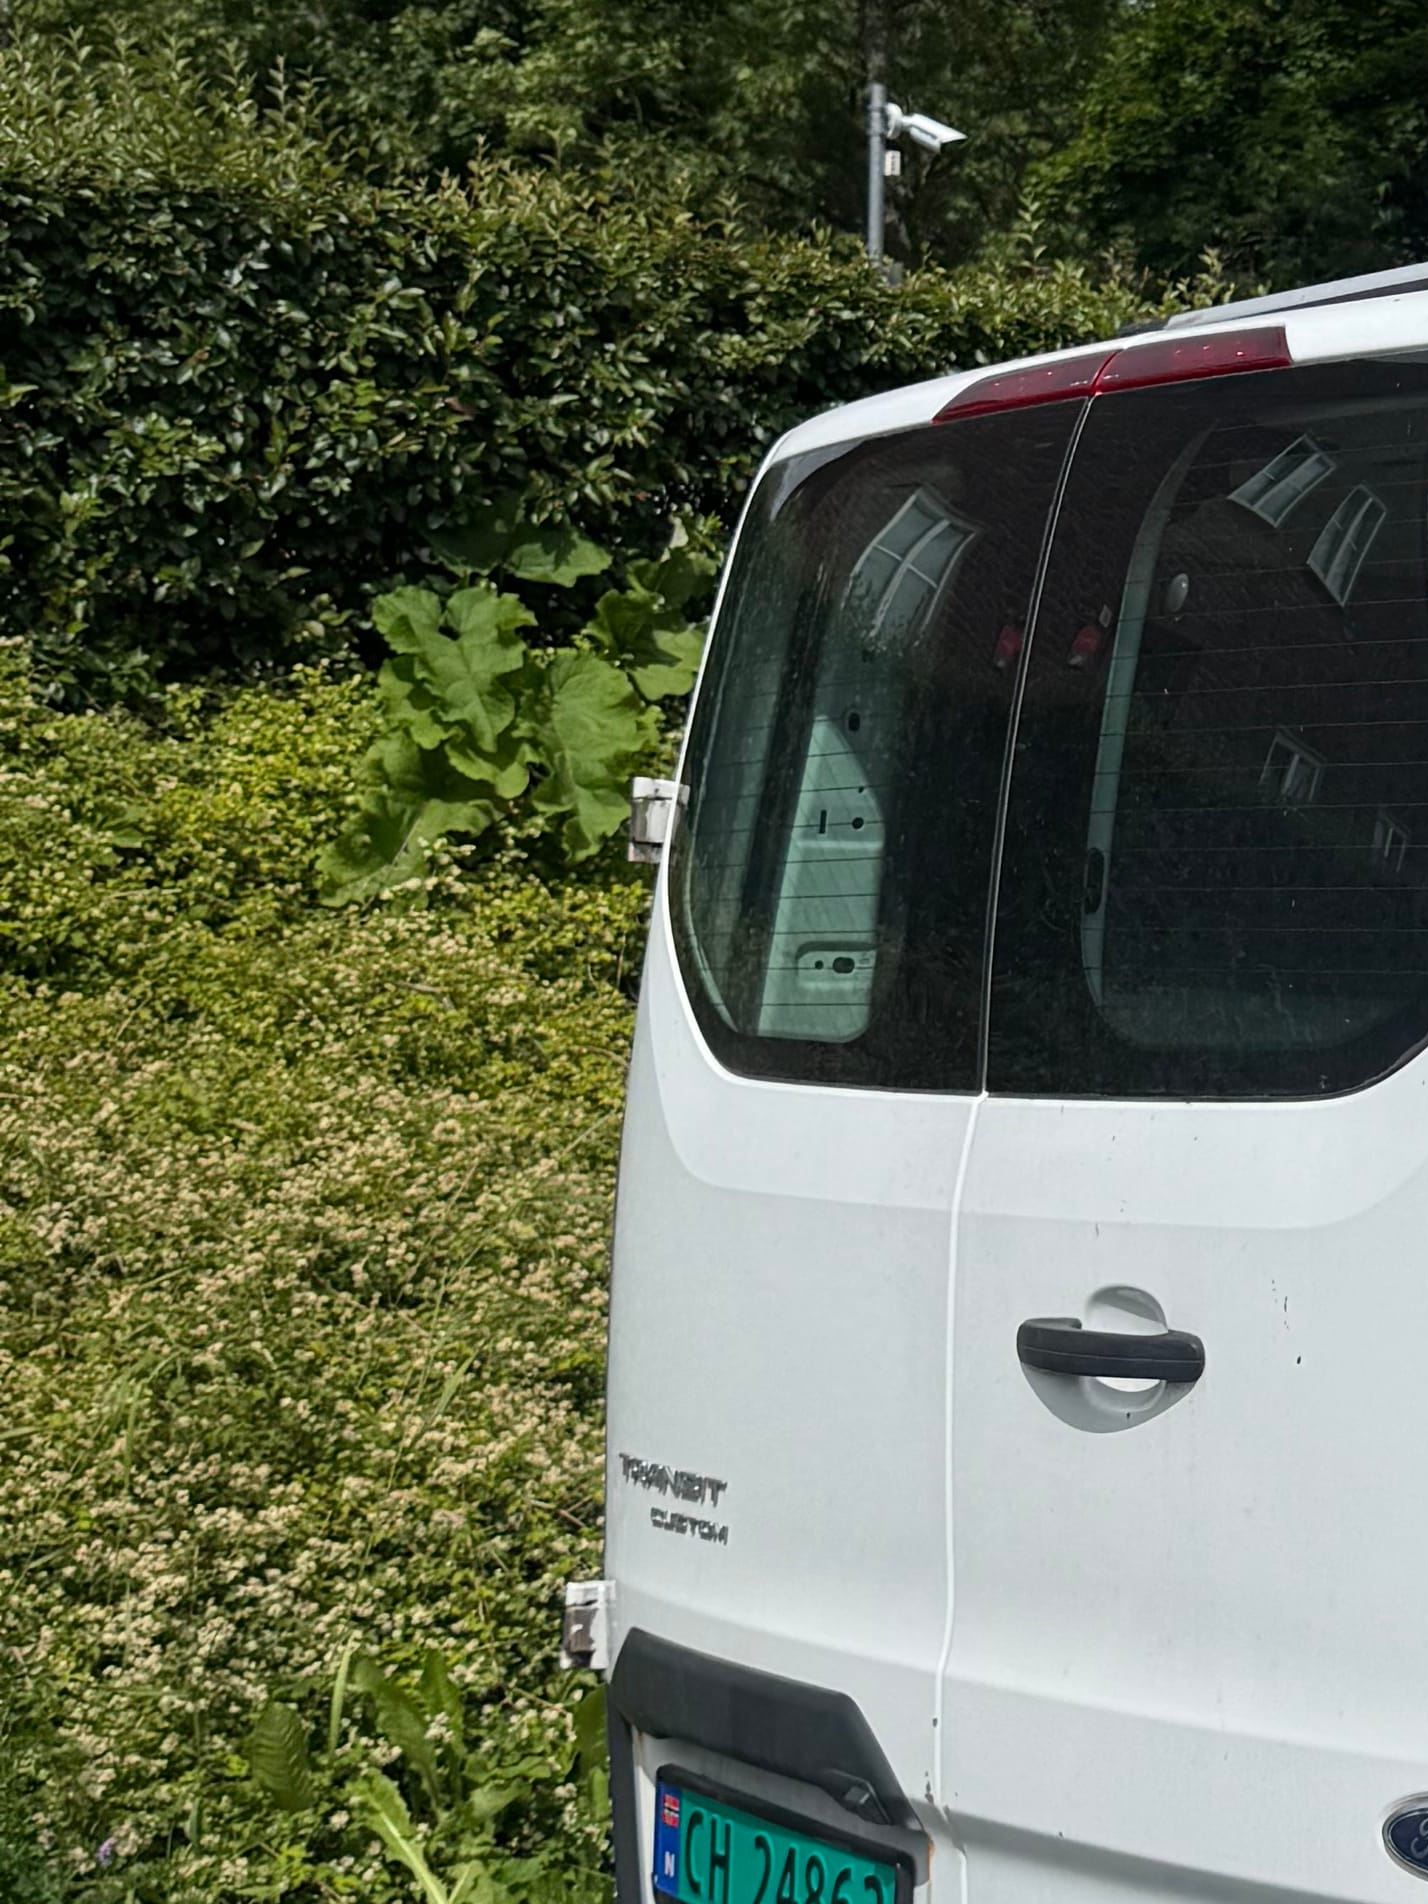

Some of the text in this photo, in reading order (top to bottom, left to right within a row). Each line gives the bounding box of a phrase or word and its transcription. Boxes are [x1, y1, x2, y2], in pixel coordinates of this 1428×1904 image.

[618, 1452, 728, 1508] TRANSIT
[650, 1507, 729, 1546] CUSTOM
[664, 1851, 675, 1878] N
